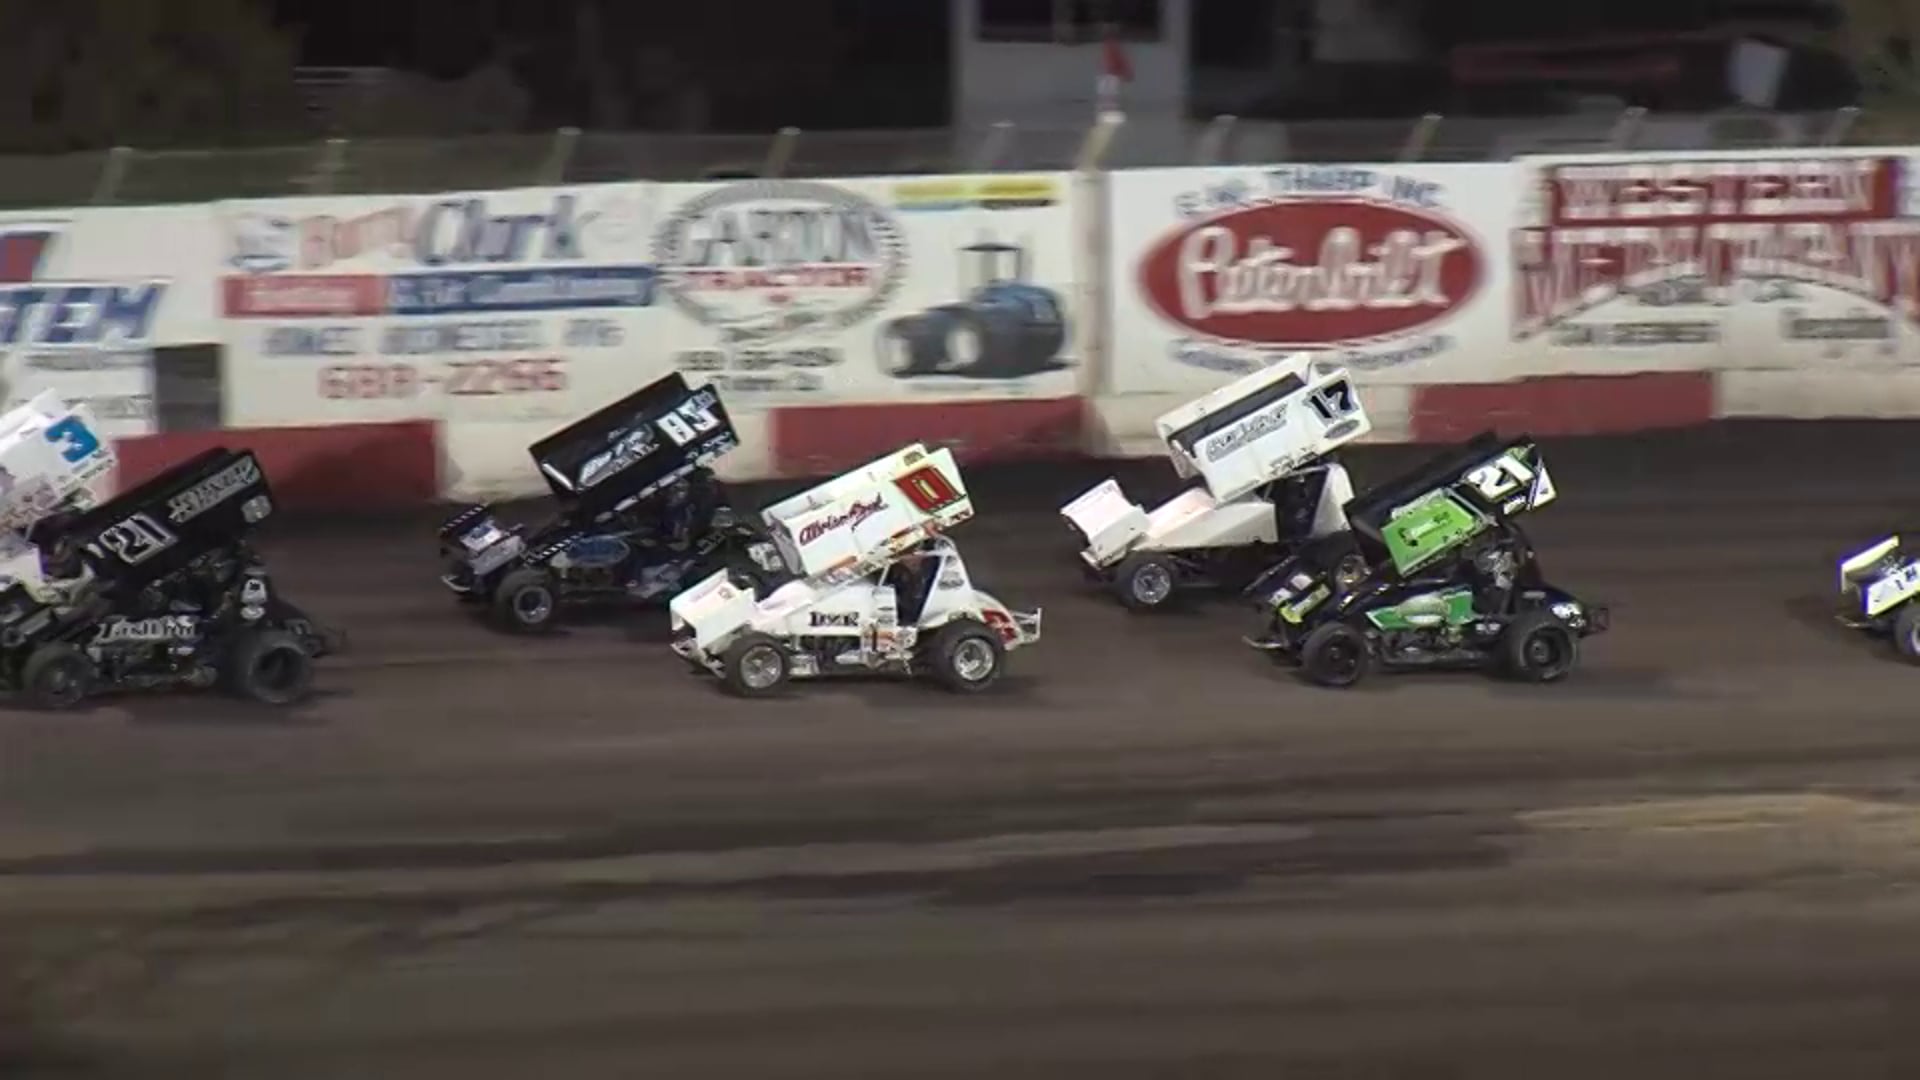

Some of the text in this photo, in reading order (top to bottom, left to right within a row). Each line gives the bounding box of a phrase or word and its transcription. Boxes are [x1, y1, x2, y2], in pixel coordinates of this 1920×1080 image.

[1179, 226, 1466, 320] Peterbilt
[1302, 379, 1362, 427] 17
[44, 416, 98, 463] 3
[1466, 455, 1535, 500] 21
